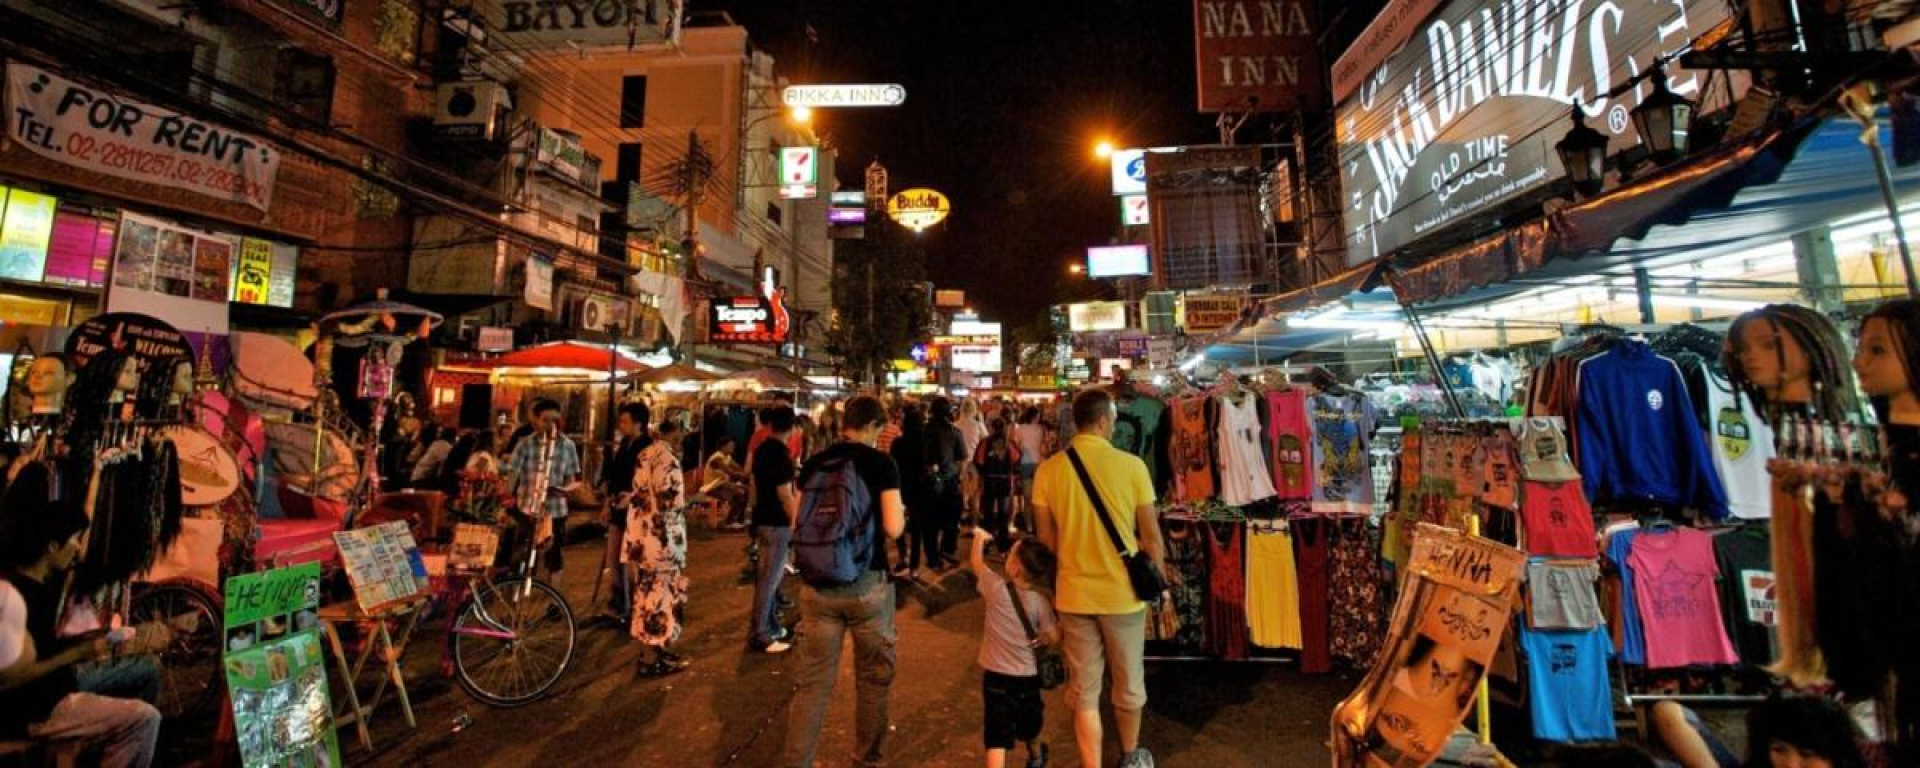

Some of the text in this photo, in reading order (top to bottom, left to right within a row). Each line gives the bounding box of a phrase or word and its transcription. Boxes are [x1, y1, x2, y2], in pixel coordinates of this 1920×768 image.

[1203, 0, 1311, 38] NA NA
[1219, 55, 1300, 87] INN
[786, 88, 881, 103] RIKKA INN
[15, 104, 62, 153] TEL.
[56, 86, 256, 166] FOR RENT
[1366, 65, 1438, 222] JACK
[1431, 133, 1509, 193] OLD TIME
[714, 304, 768, 326] Tempo
